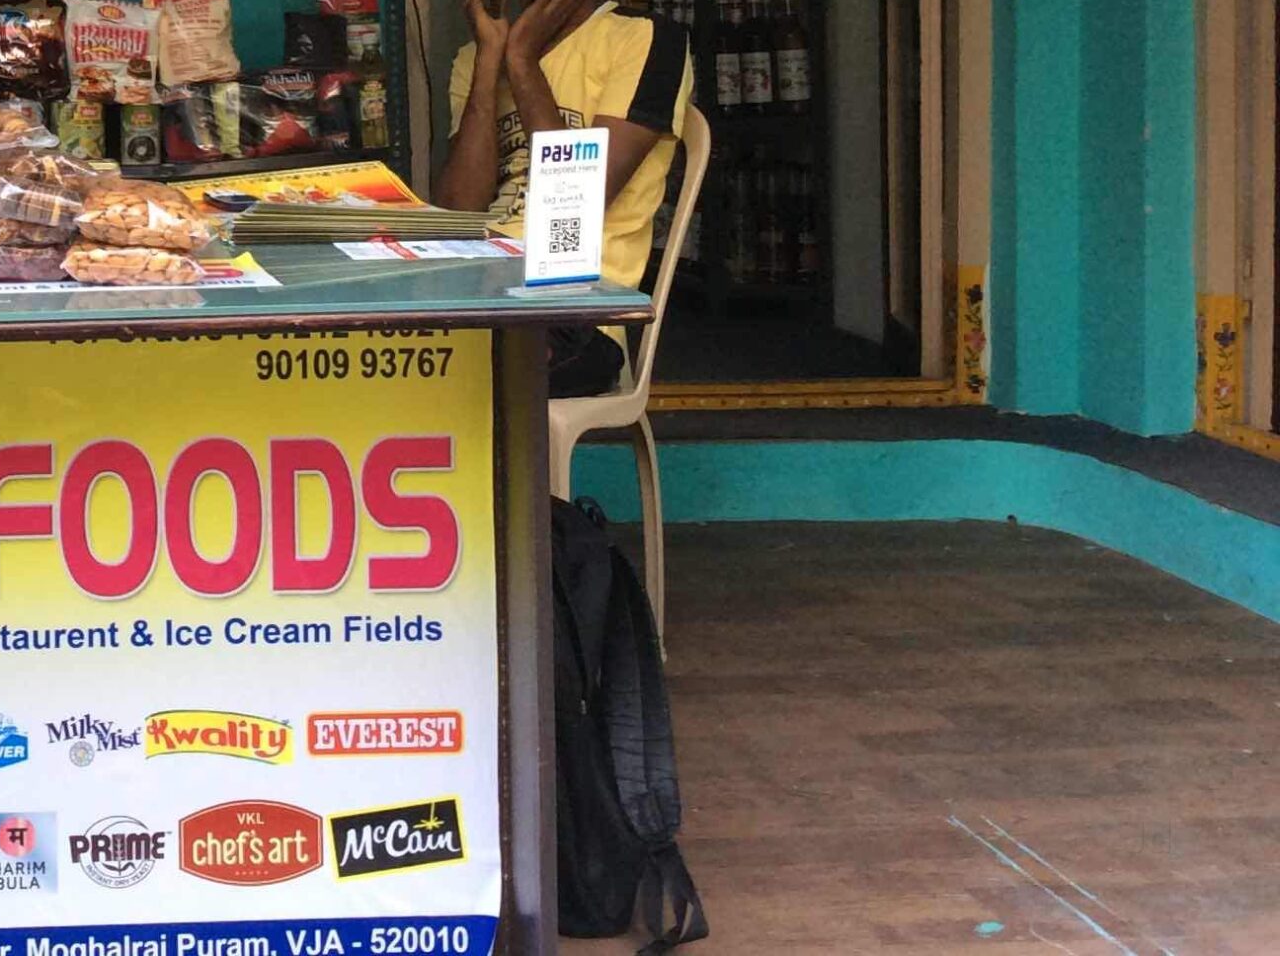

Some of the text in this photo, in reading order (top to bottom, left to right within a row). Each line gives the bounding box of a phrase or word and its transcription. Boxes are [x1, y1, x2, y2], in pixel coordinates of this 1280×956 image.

[256, 347, 454, 381] 90109 93767
[131, 619, 155, 647] &
[166, 619, 213, 646] Ice
[223, 618, 332, 645] Cream
[343, 615, 443, 644] Fields
[46, 713, 113, 744] Milky
[96, 726, 139, 752] Mist
[146, 717, 289, 758] Kwality
[313, 717, 458, 750] EVEREST
[236, 813, 265, 825] VKL
[69, 831, 166, 863] PRIME
[192, 830, 309, 867] chef's art
[340, 817, 461, 867] McCain
[286, 929, 344, 954] VJA
[370, 925, 470, 953] 520010
